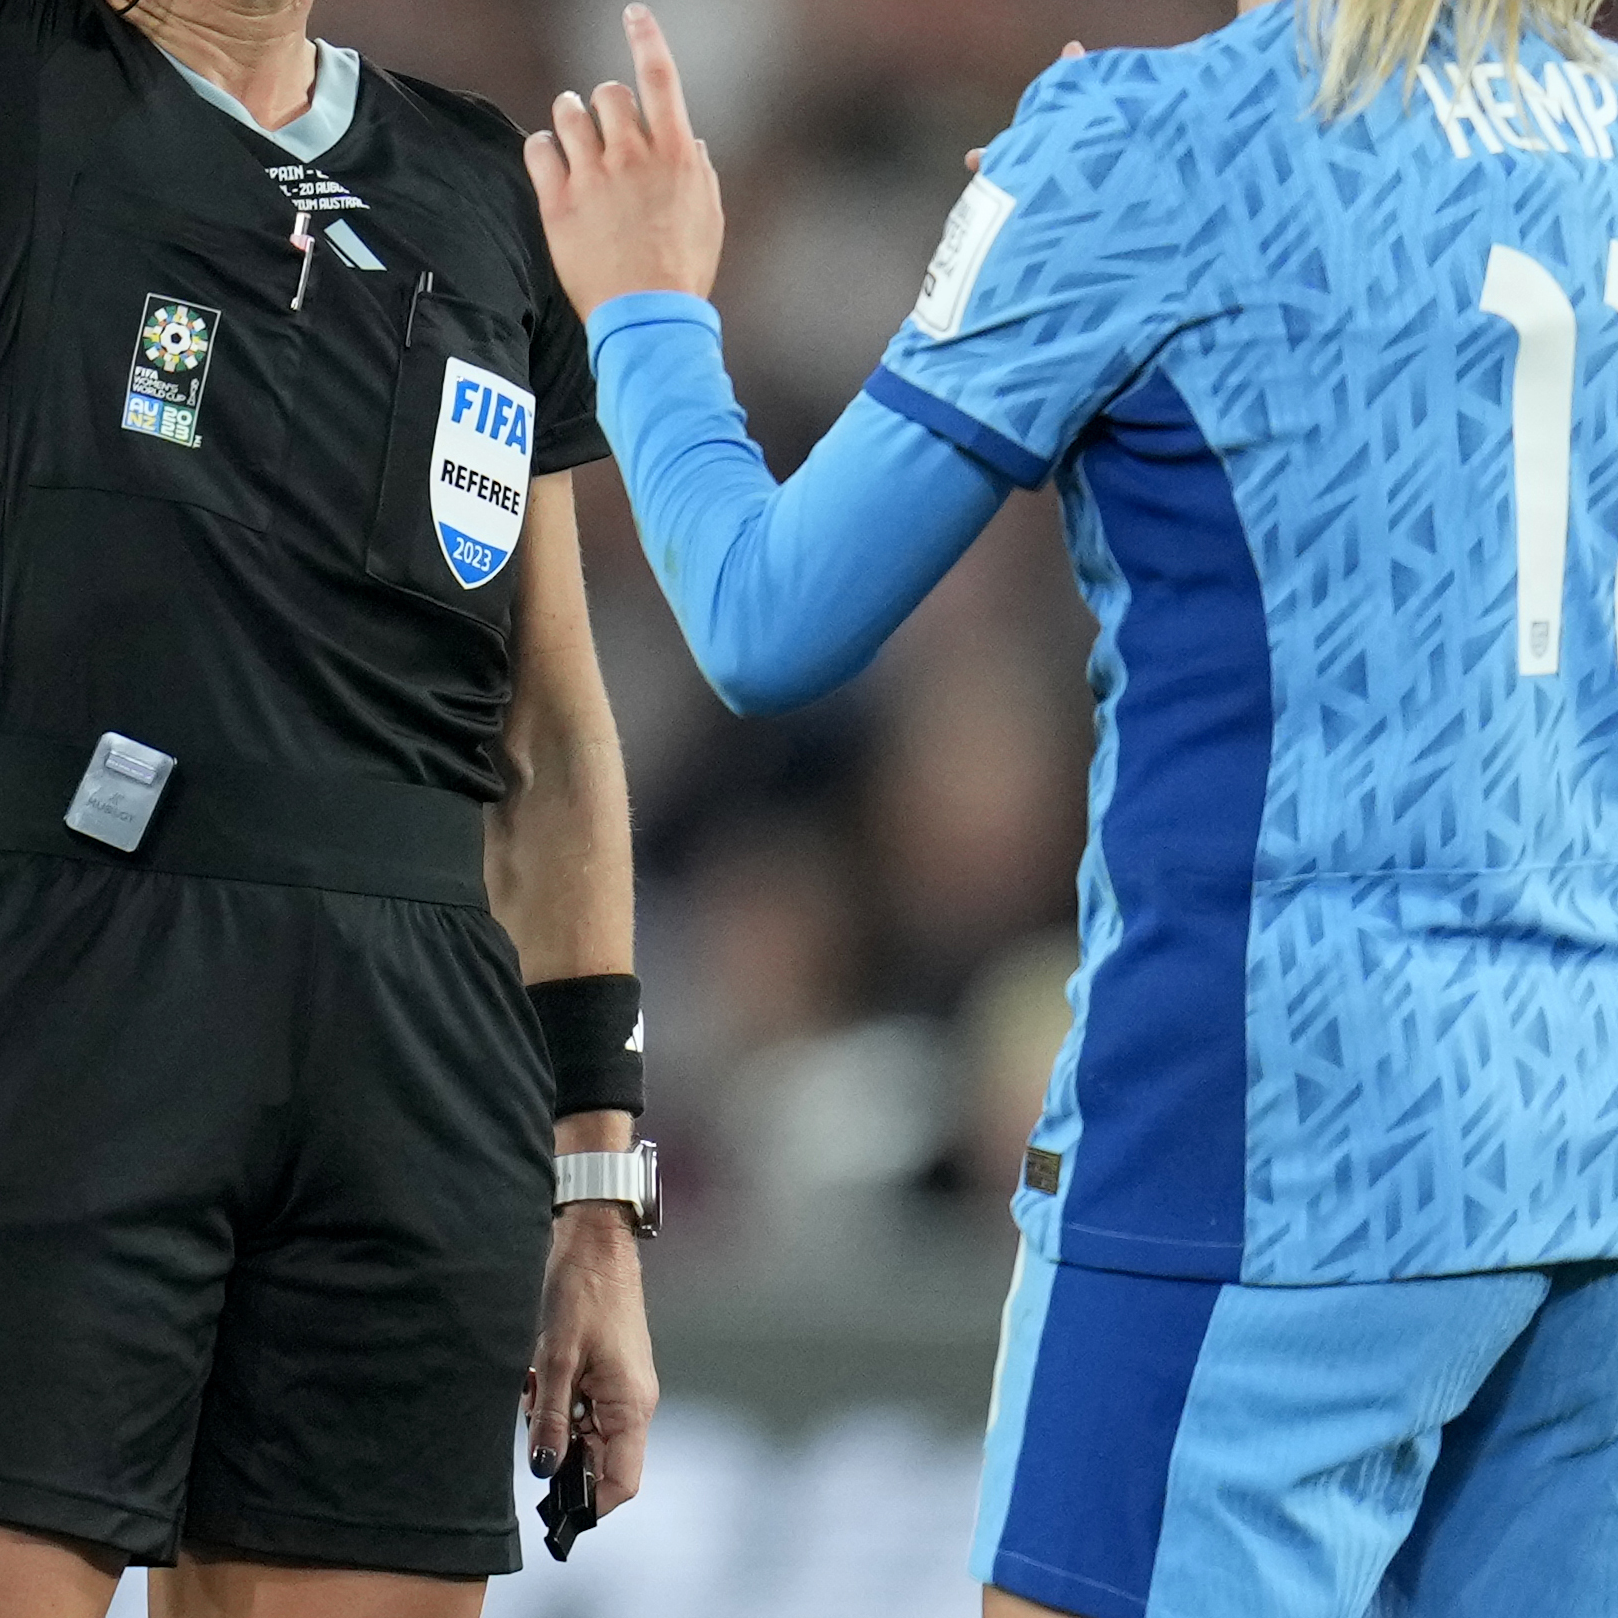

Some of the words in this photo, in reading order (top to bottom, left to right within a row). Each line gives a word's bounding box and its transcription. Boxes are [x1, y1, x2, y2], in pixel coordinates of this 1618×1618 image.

[1416, 61, 1618, 159] HEMP
[265, 165, 304, 181] PAIN
[299, 183, 314, 196] 20
[134, 366, 158, 381] FIFA
[133, 383, 166, 399] WORLD
[166, 391, 187, 402] CUP
[129, 397, 159, 416] AU
[451, 376, 527, 455] FIFA
[127, 412, 156, 431] NZ
[440, 459, 521, 516] REFEREE
[453, 537, 492, 572] 2023
